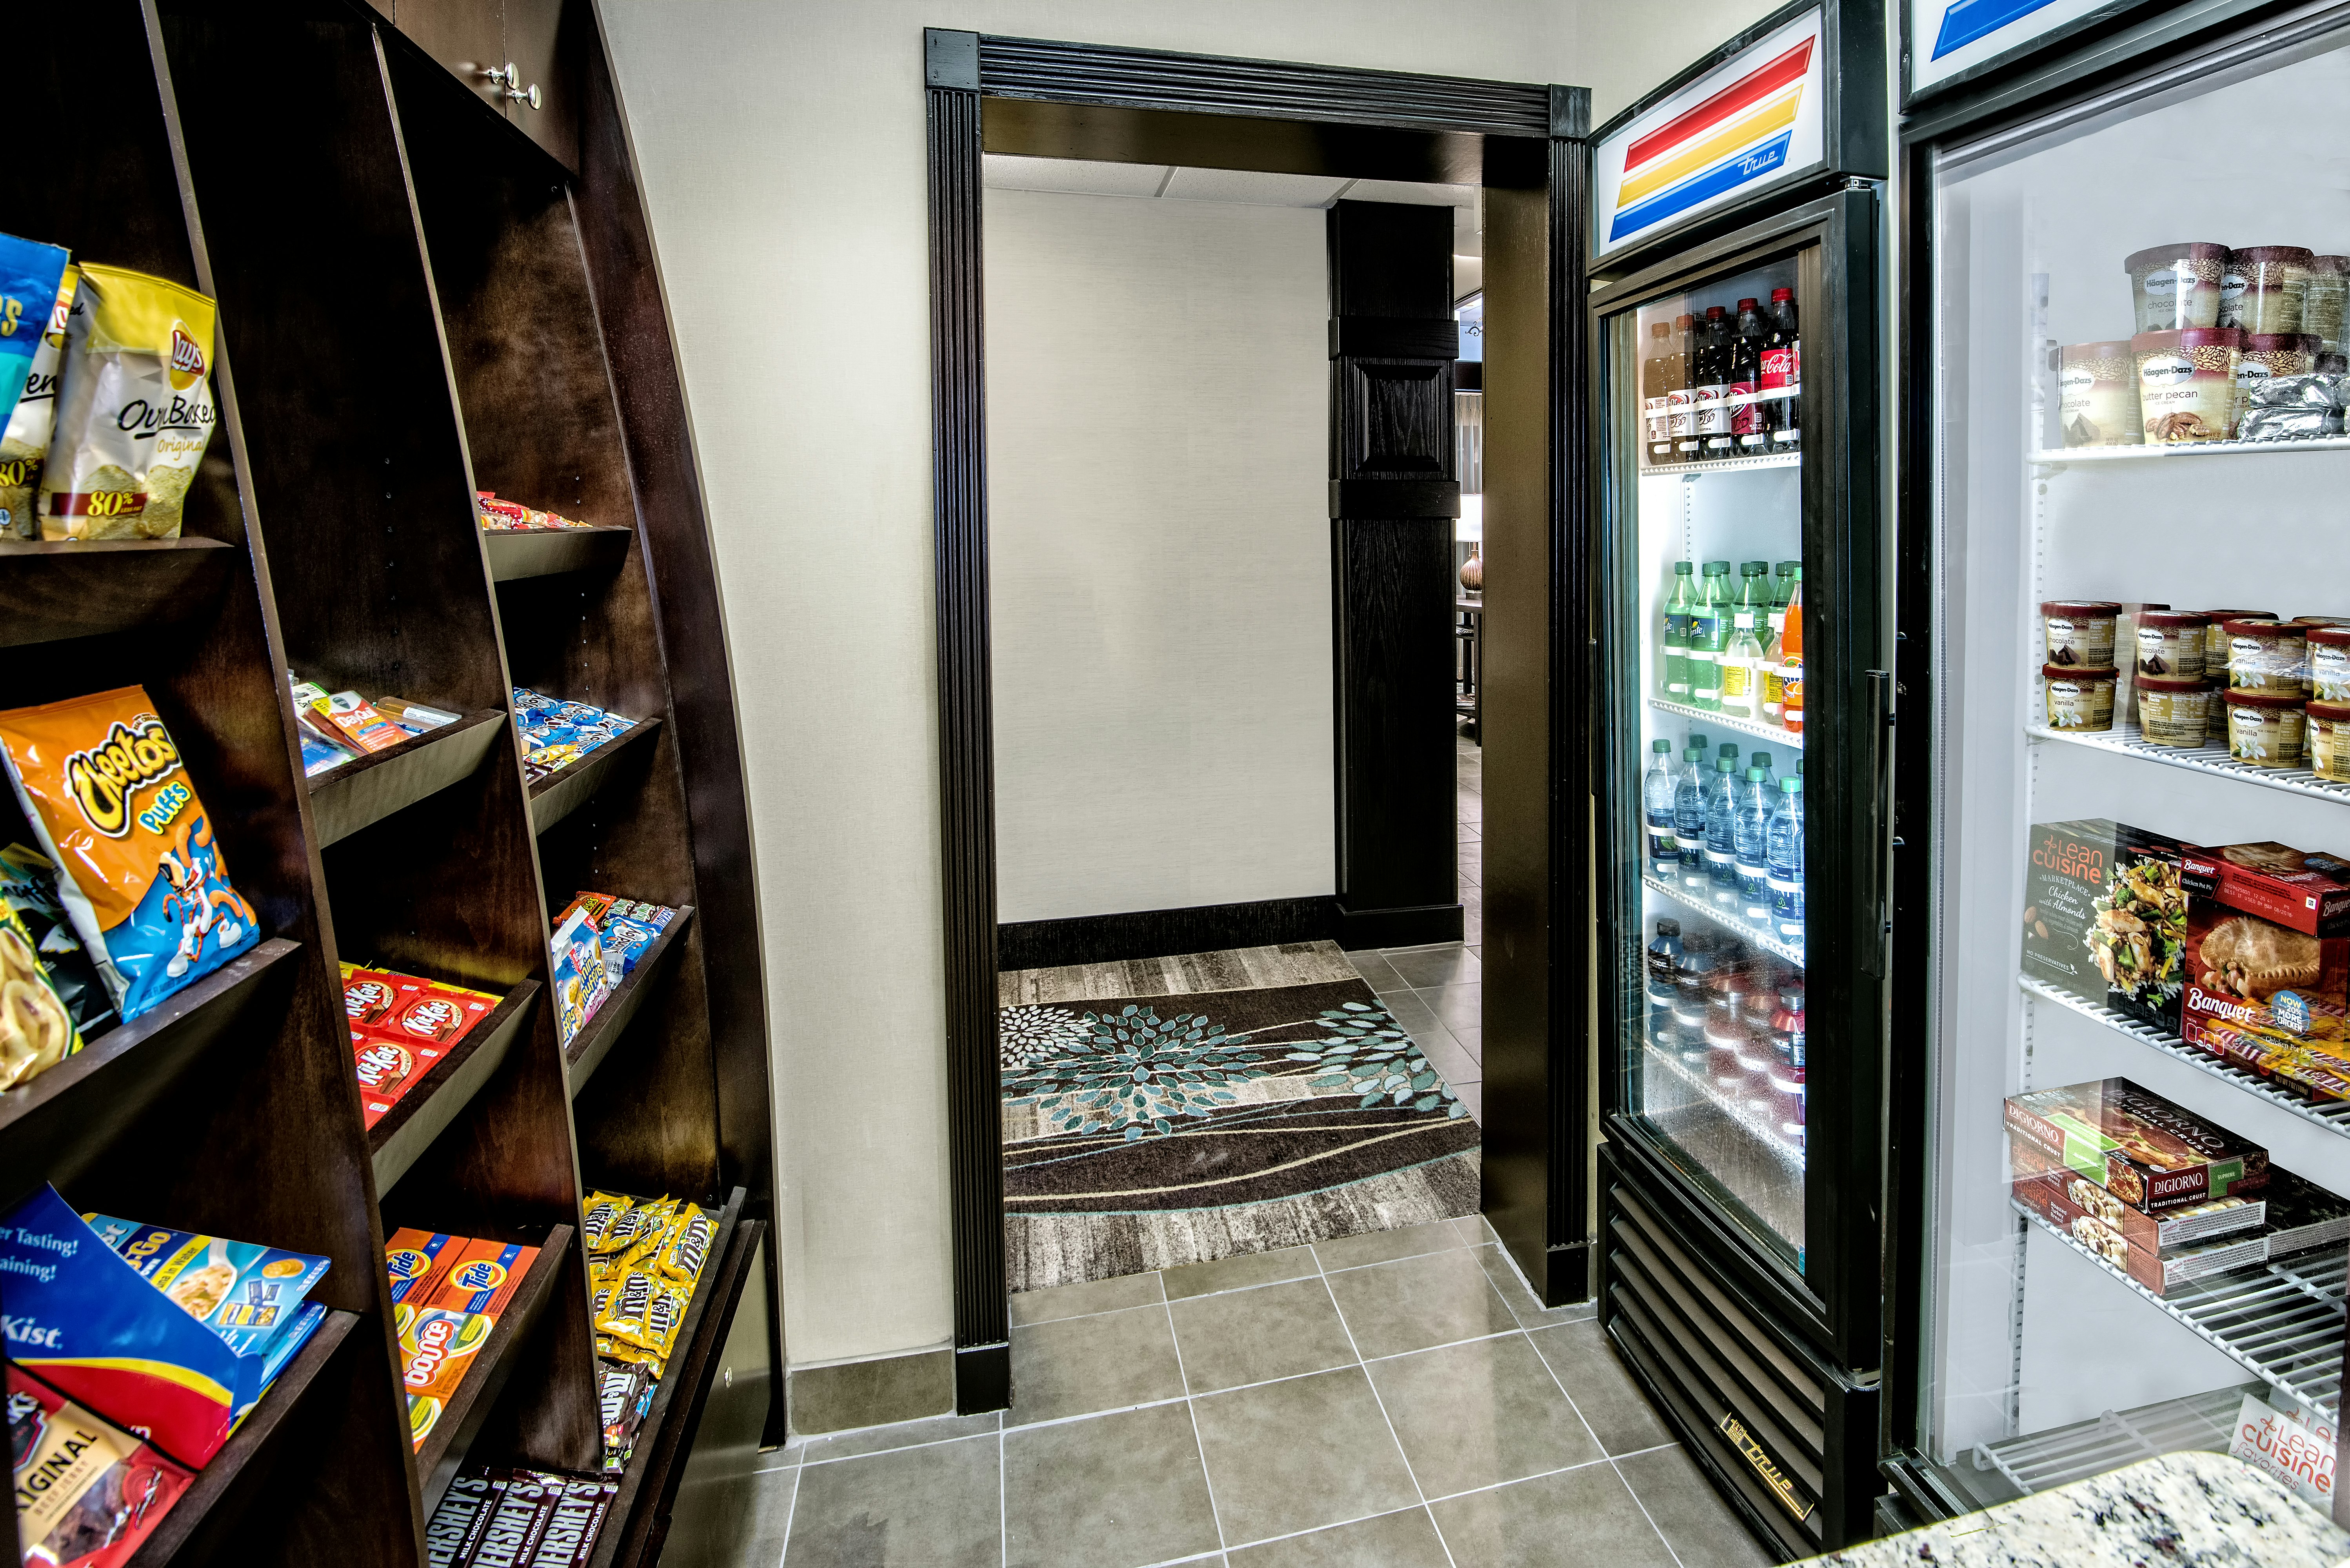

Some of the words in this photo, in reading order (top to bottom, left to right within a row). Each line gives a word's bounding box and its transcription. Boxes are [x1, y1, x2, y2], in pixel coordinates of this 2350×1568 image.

[1738, 150, 1779, 175] true
[2146, 277, 2196, 288] Häagen-azs
[2148, 298, 2192, 310] chocolte
[171, 331, 203, 372] Lay's
[2143, 365, 2193, 377] Häagen-Dazs
[2237, 370, 2269, 379] en-Dazs
[2143, 391, 2163, 401] butter
[2166, 390, 2198, 402] pecan
[157, 436, 205, 461] Original
[2048, 622, 2073, 631] Häagen-Dazs
[2048, 637, 2075, 645] chocolate
[2232, 642, 2261, 651] Häagen-Dazs
[2138, 646, 2165, 655] chocolate
[2315, 652, 2345, 662] Häagen-Dazs
[2318, 668, 2340, 677] vanilla
[335, 706, 378, 728] DayQuil
[365, 716, 385, 726] SEVERE
[2233, 713, 2263, 723] Häagen-Dazs
[2236, 728, 2257, 737] vanilla
[71, 727, 177, 830] Cheetos
[2183, 859, 2216, 875] Banquet
[2042, 875, 2088, 897] MARKETPLACE
[2182, 878, 2199, 887] Chicken
[2048, 886, 2078, 905] Chicken
[2244, 895, 2256, 904] USED
[2052, 899, 2086, 920] Almonds
[2323, 899, 2350, 917] Banque
[2034, 951, 2070, 971] PRESERVATIVES
[582, 962, 603, 1004] muffins
[589, 986, 603, 1012] birthday
[2188, 988, 2255, 1023] Banquet
[2280, 995, 2301, 1008] NOW
[2277, 1009, 2303, 1025] MORE
[2287, 1005, 2302, 1016] 20%
[2277, 1017, 2303, 1033] CHICKEN
[2265, 1036, 2289, 1049] Chicken
[2290, 1044, 2299, 1053] Pot
[2300, 1047, 2310, 1056] Pie
[2282, 1077, 2288, 1085] WT
[2296, 1083, 2308, 1096] (198g)
[2006, 1122, 2042, 1147] TRADITIONAL
[2043, 1143, 2061, 1158] CRUST
[2168, 1128, 2213, 1155] CRUST
[2047, 1165, 2063, 1180] Roasted
[2048, 1171, 2061, 1183] Turkey
[2217, 1171, 2235, 1180] SUPREME
[2047, 1177, 2061, 1188] Breast
[2050, 1201, 2067, 1216] Roasted
[2151, 1196, 2188, 1209] TRADITIONAL
[2189, 1192, 2206, 1201] CRUST
[2050, 1213, 2064, 1224] Breast
[2051, 1207, 2064, 1220] Turkey
[16, 1227, 79, 1258] Tasting!
[171, 1247, 199, 1267] Water
[387, 1251, 417, 1280] Tide
[462, 1262, 493, 1291] Tide
[405, 1322, 448, 1385] bounce
[17, 1430, 98, 1511] IGINAL
[1745, 1433, 1797, 1504] true
[2231, 1441, 2299, 1490] favorites
[459, 1541, 473, 1559] MILK
[468, 1499, 493, 1541] CHOCOLATE
[518, 1545, 532, 1564] MILK
[526, 1505, 549, 1546] CHOCOLATE
[578, 1542, 590, 1559] MILK
[585, 1502, 605, 1542] CHOCOLATE
